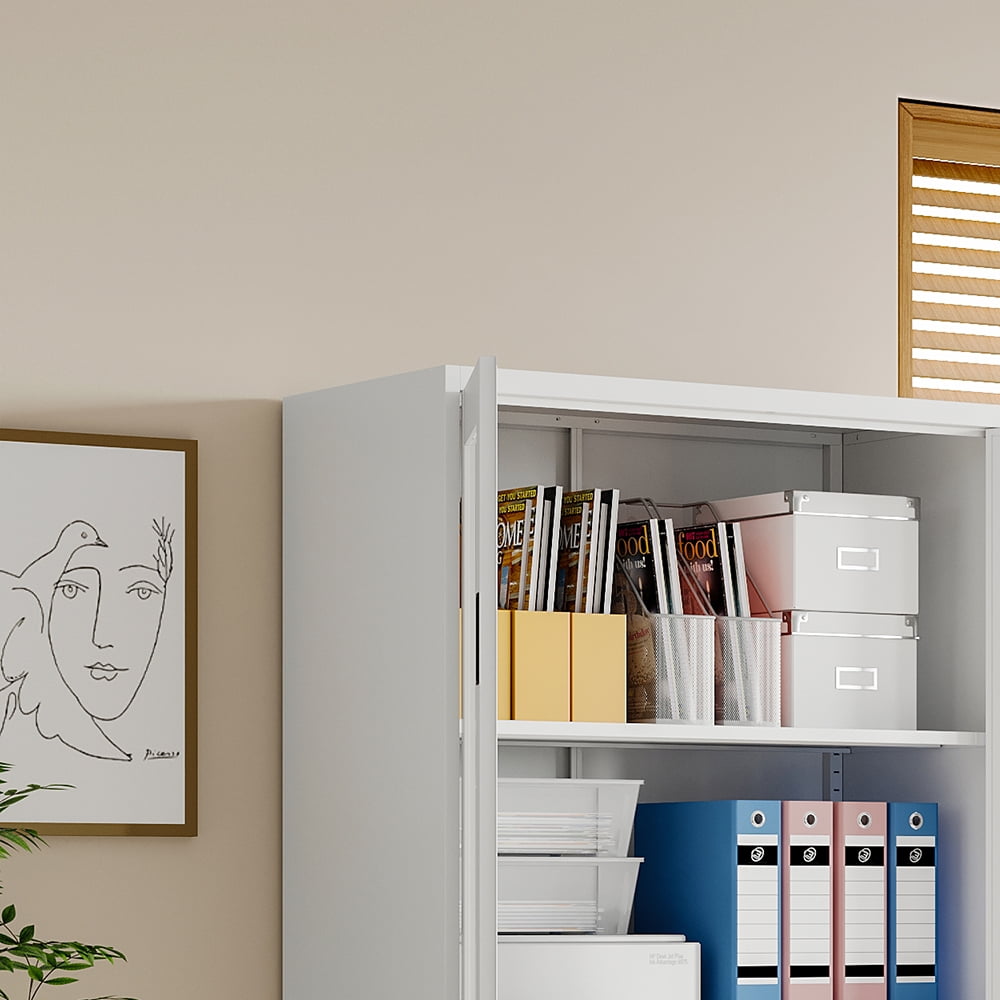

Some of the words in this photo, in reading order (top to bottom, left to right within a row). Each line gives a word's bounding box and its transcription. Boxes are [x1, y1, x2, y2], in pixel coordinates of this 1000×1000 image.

[497, 520, 524, 549] OME
[617, 525, 651, 557] ood
[678, 528, 719, 561] food
